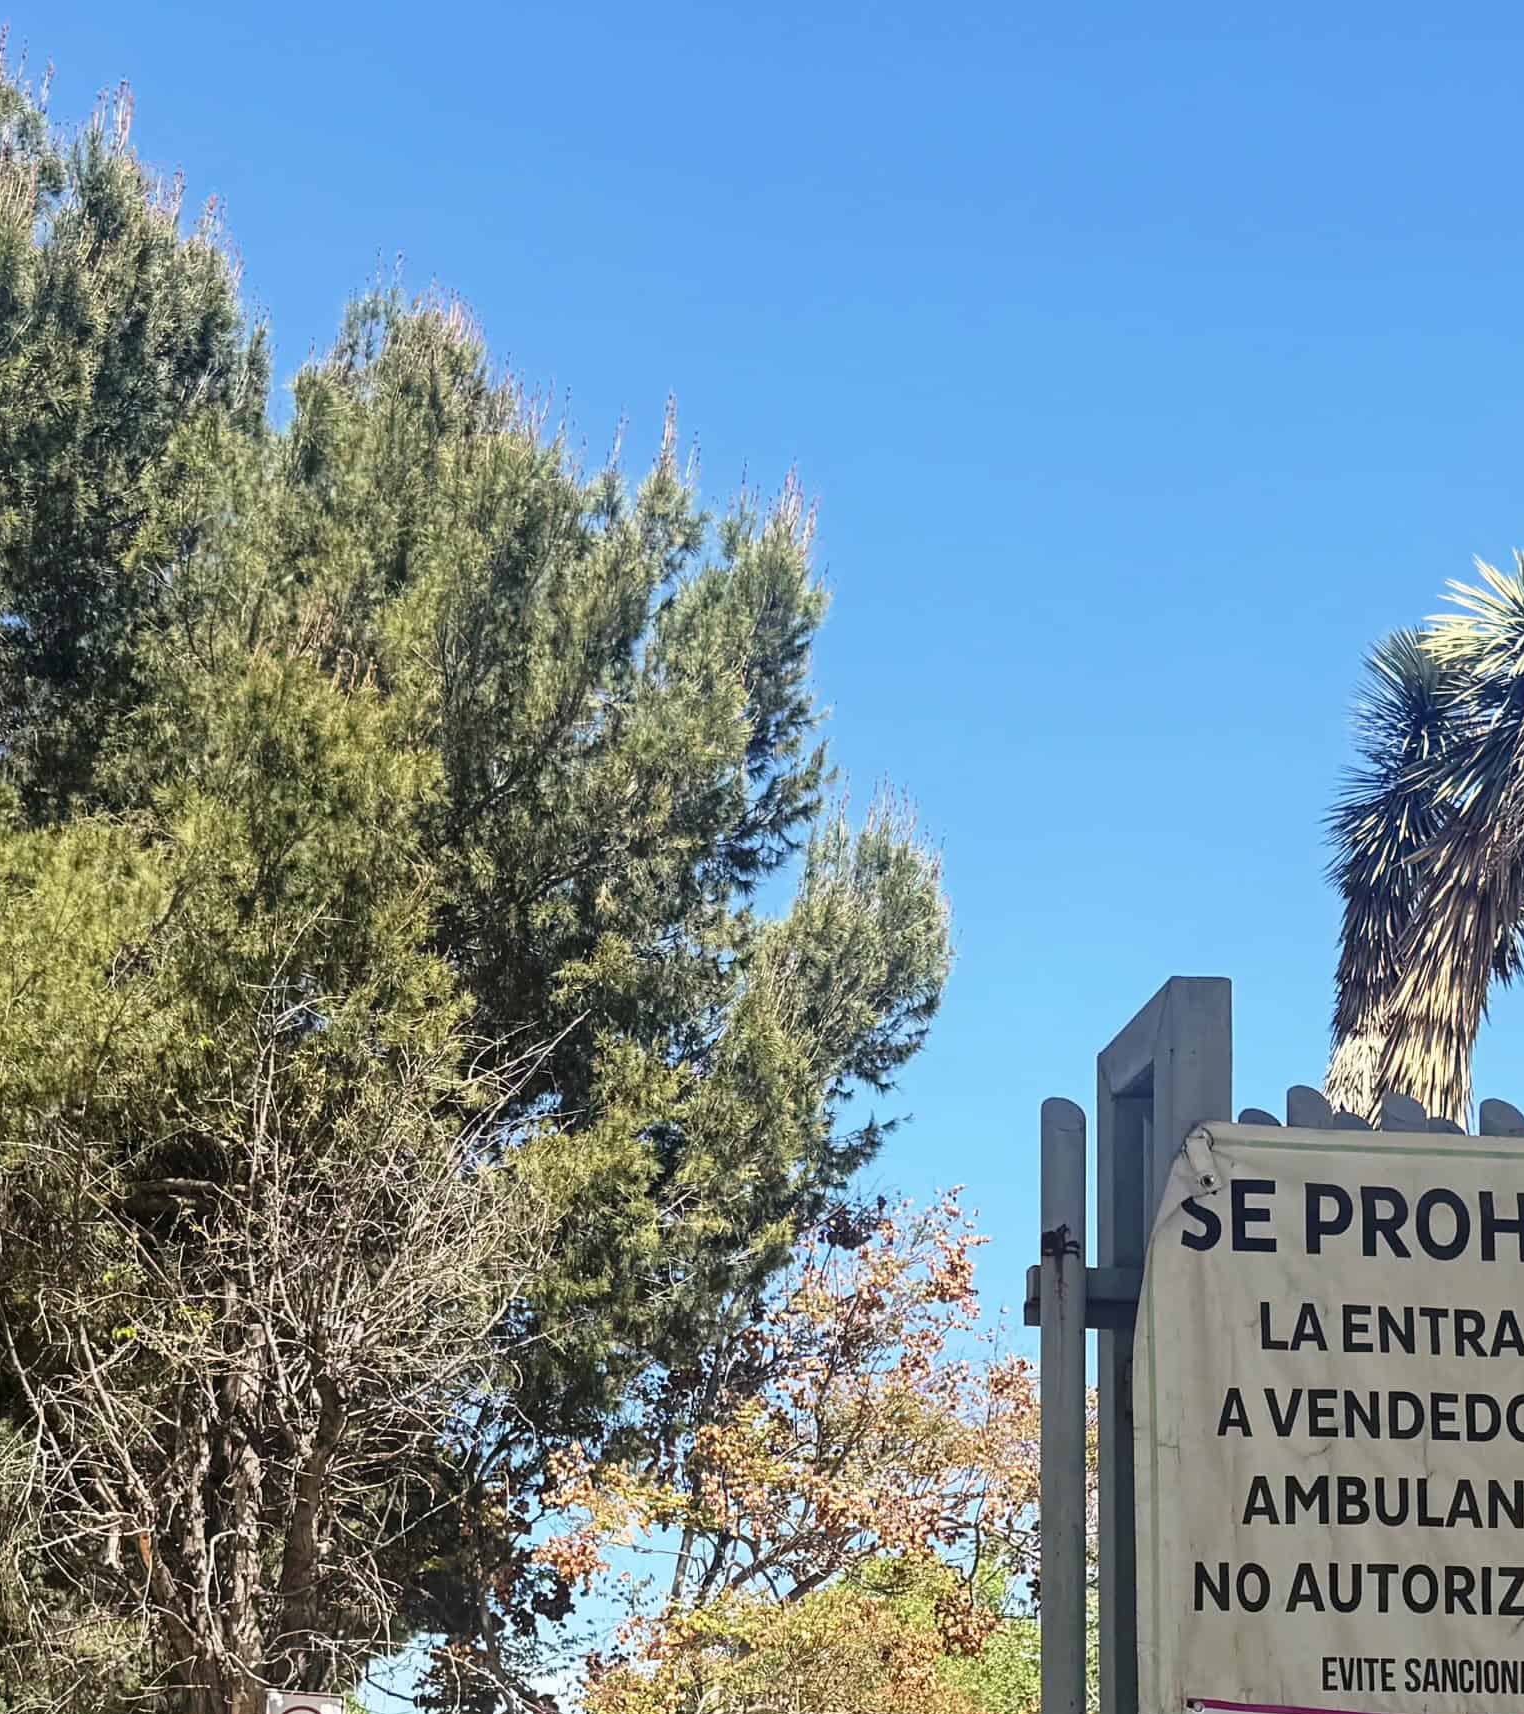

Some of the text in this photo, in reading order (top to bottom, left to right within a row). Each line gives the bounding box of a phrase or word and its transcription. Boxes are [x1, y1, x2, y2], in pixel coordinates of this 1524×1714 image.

[1181, 1180, 1277, 1252] SE
[1261, 1302, 1327, 1351] LA
[1218, 1388, 1252, 1437] A
[1194, 1562, 1271, 1612] NO
[1321, 1657, 1396, 1692] EVITE
